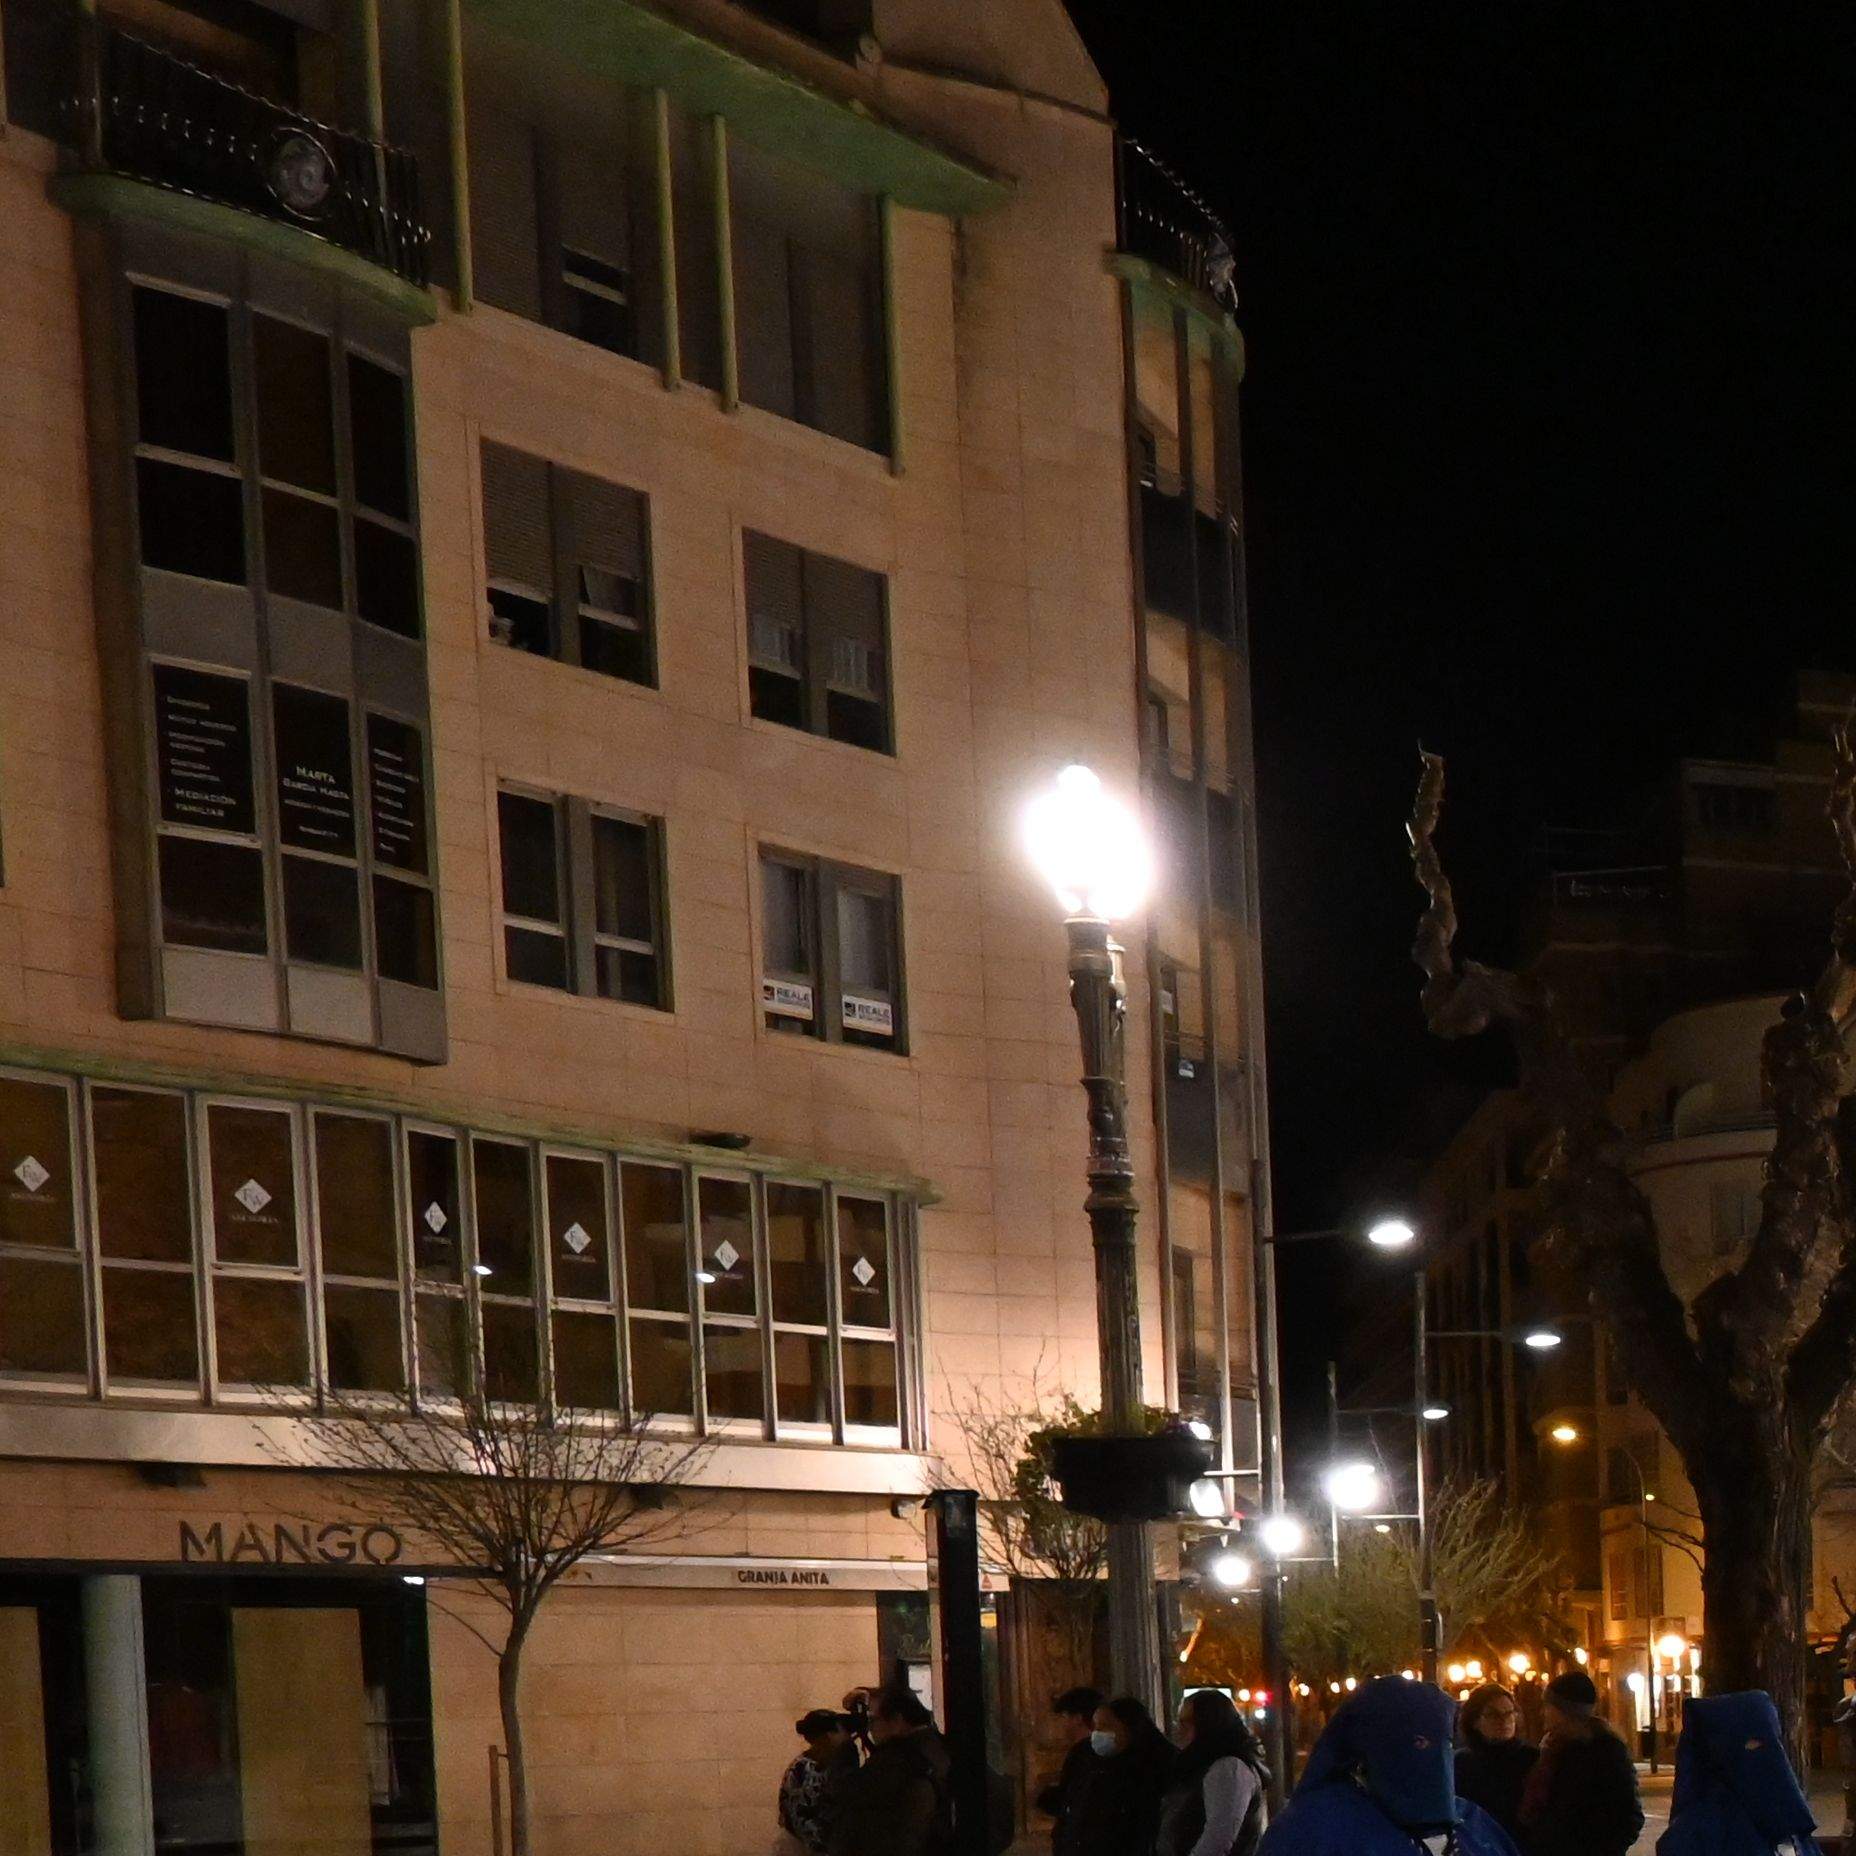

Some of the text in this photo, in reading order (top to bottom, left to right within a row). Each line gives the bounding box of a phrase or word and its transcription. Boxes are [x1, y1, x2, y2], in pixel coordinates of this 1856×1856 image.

[776, 987, 810, 1002] REALE
[858, 1003, 890, 1018] REALE
[179, 1519, 402, 1566] MANGO
[738, 1570, 829, 1585] GRANJA ANITA
